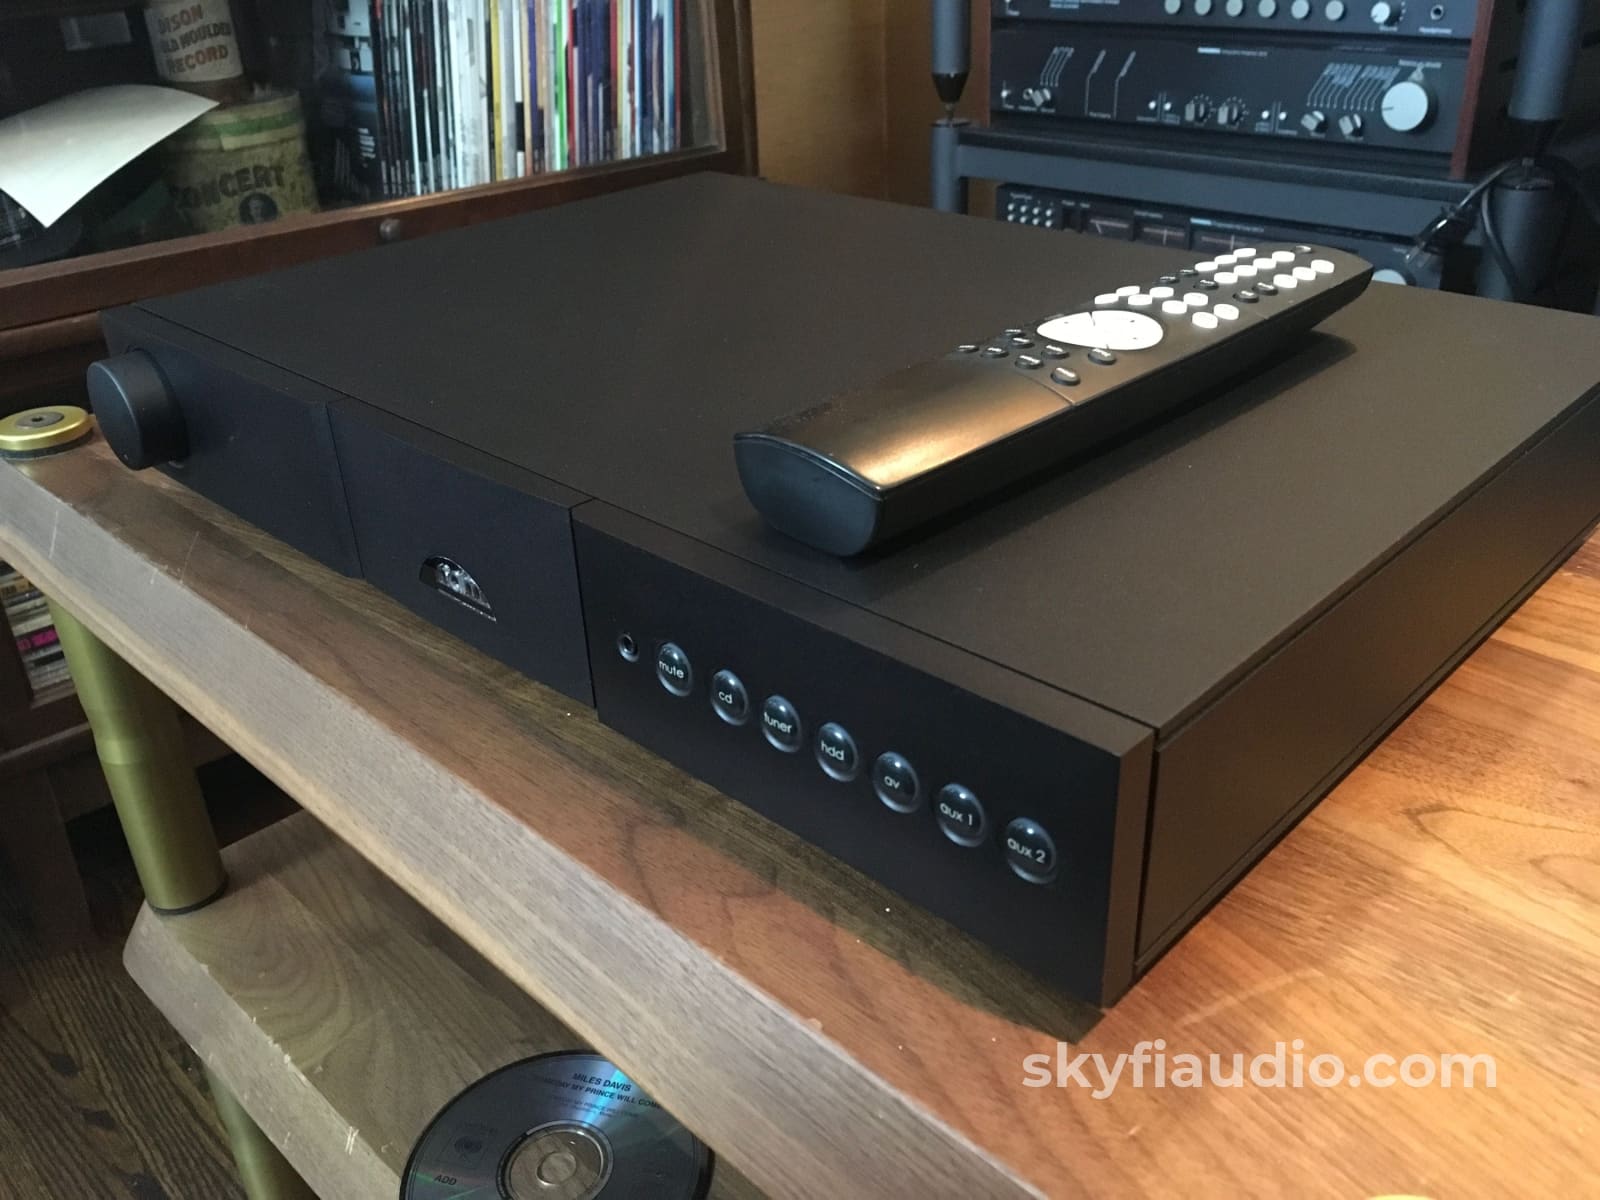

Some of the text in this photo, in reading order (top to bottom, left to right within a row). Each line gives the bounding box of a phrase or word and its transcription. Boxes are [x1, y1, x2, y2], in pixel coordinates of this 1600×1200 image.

[169, 164, 285, 208] ONCERT
[658, 660, 685, 679] mute
[718, 689, 733, 705] cd
[763, 712, 793, 734] tuner
[820, 740, 845, 761] hdd
[884, 776, 900, 789] av
[940, 802, 974, 826] aux 1
[1007, 838, 1046, 863] aux 2
[572, 1072, 632, 1092] MILES DAVIS
[585, 1086, 616, 1100] PRINCE
[616, 1094, 637, 1105] WILL
[638, 1098, 660, 1109] COM
[434, 1174, 457, 1186] ADD
